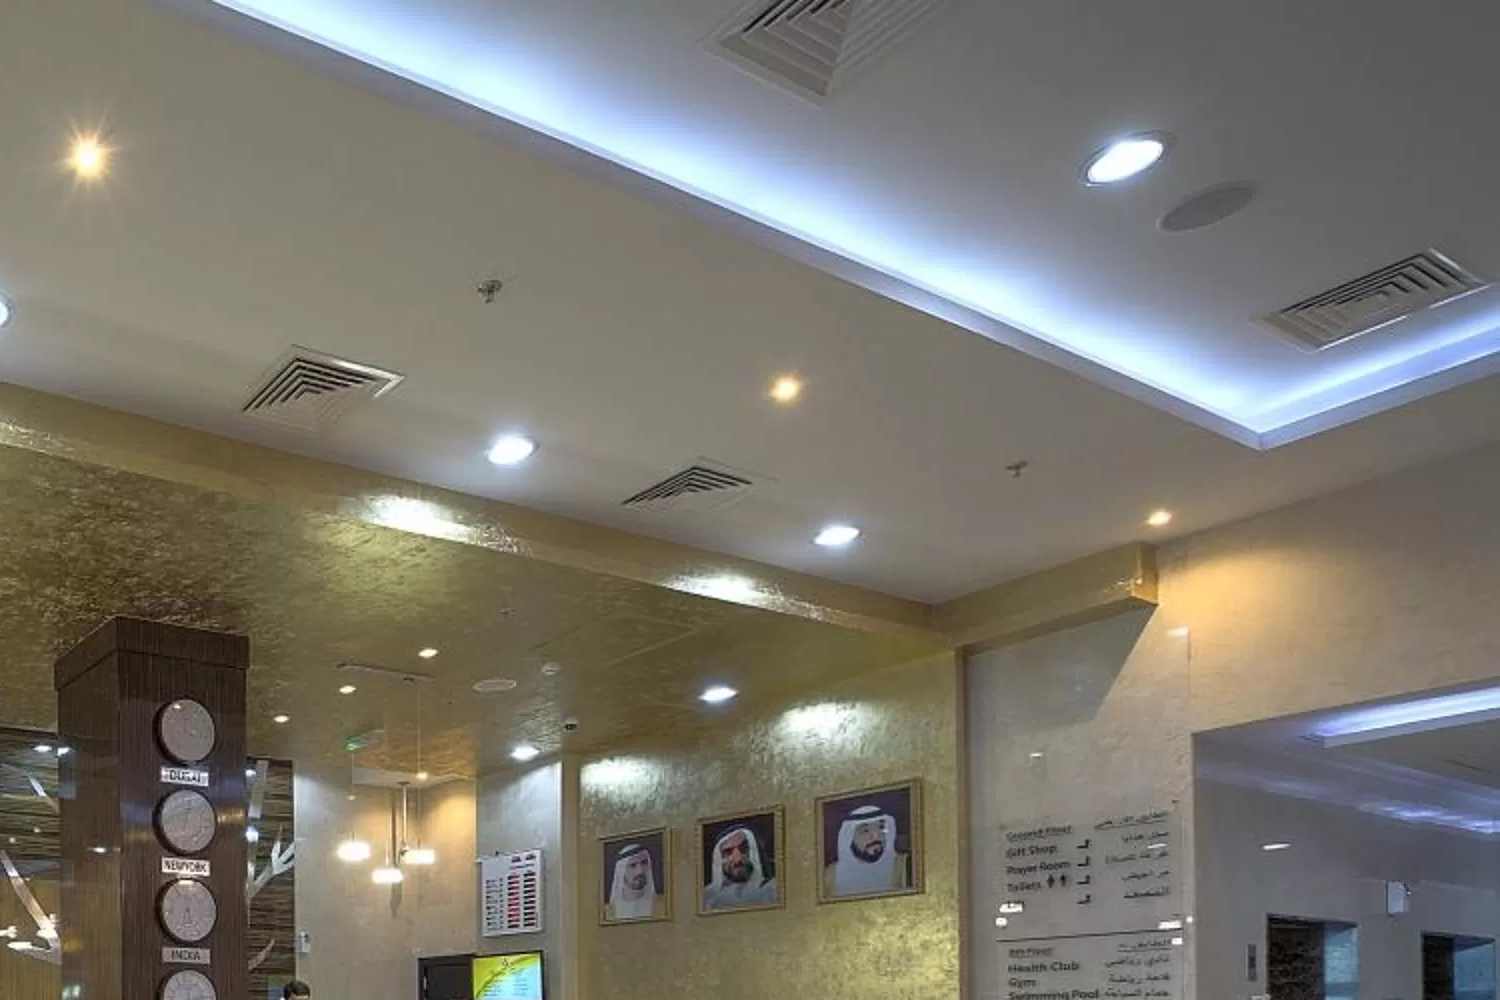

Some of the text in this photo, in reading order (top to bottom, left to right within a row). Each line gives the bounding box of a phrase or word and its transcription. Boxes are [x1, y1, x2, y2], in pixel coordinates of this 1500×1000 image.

[1028, 845, 1058, 856] Shop
[1006, 861, 1071, 876] Prayer Room
[1008, 961, 1080, 973] Health Club
[1008, 977, 1037, 989] Gym
[1071, 988, 1100, 999] Pool
